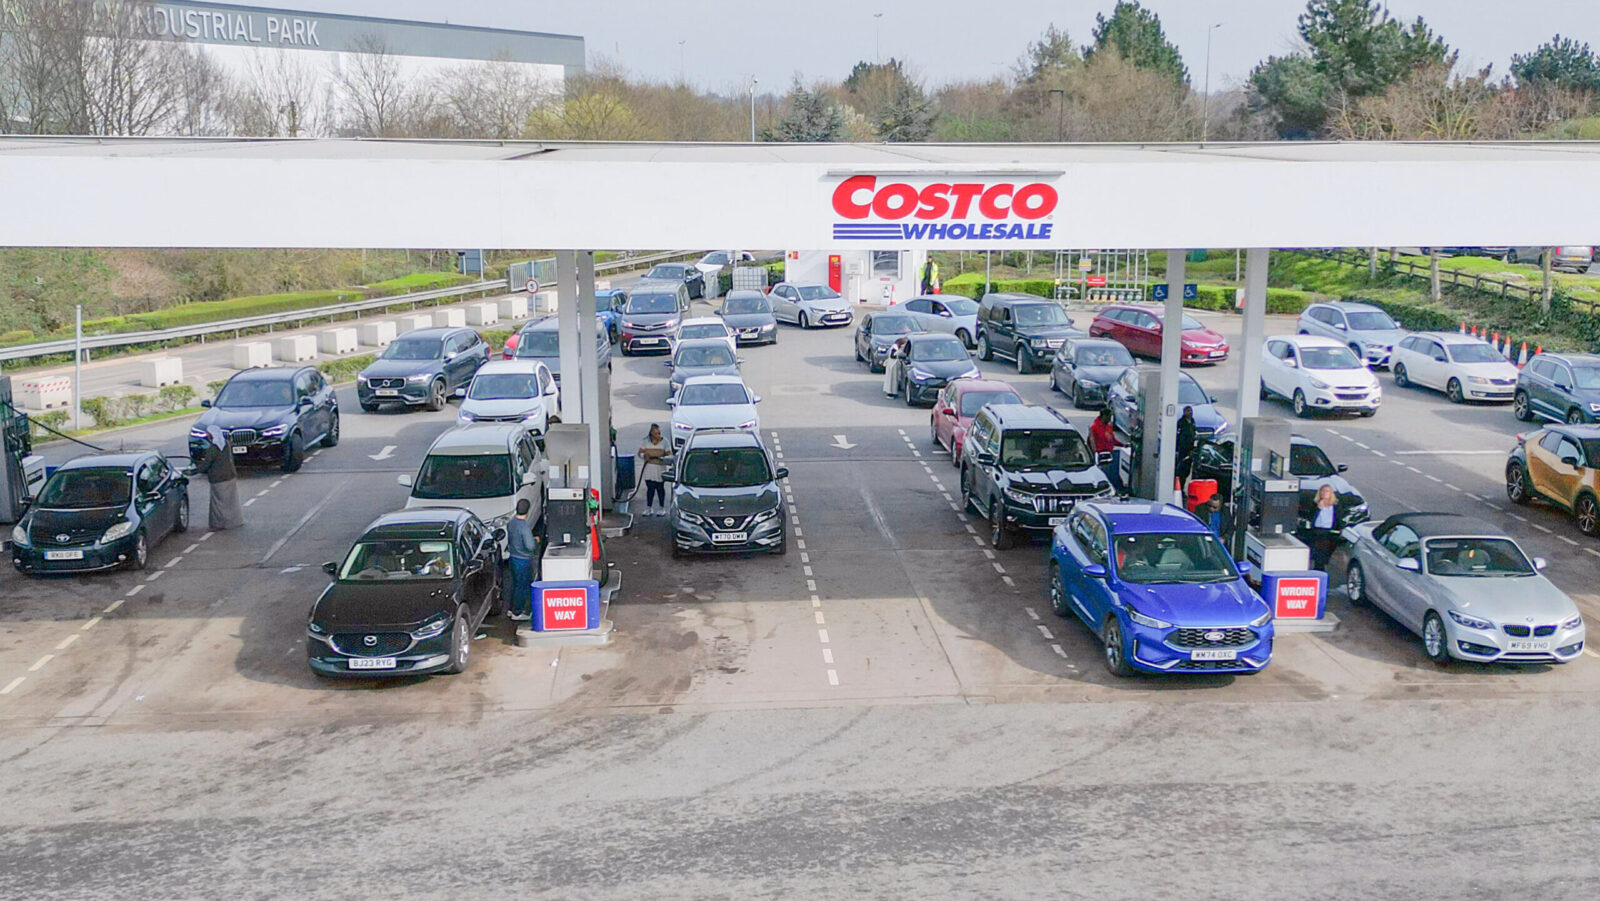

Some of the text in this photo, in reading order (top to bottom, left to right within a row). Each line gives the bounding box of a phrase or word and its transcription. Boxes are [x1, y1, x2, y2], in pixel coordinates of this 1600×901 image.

[266, 16, 320, 46] PARK
[832, 175, 1059, 220] COSTCO
[901, 223, 1053, 240] WHOLESALE
[1280, 586, 1315, 597] WRONG
[546, 597, 583, 607] WRONG
[1286, 599, 1308, 610] WAY
[553, 610, 577, 621] WAY
[353, 658, 392, 667] BJ23 RYG
